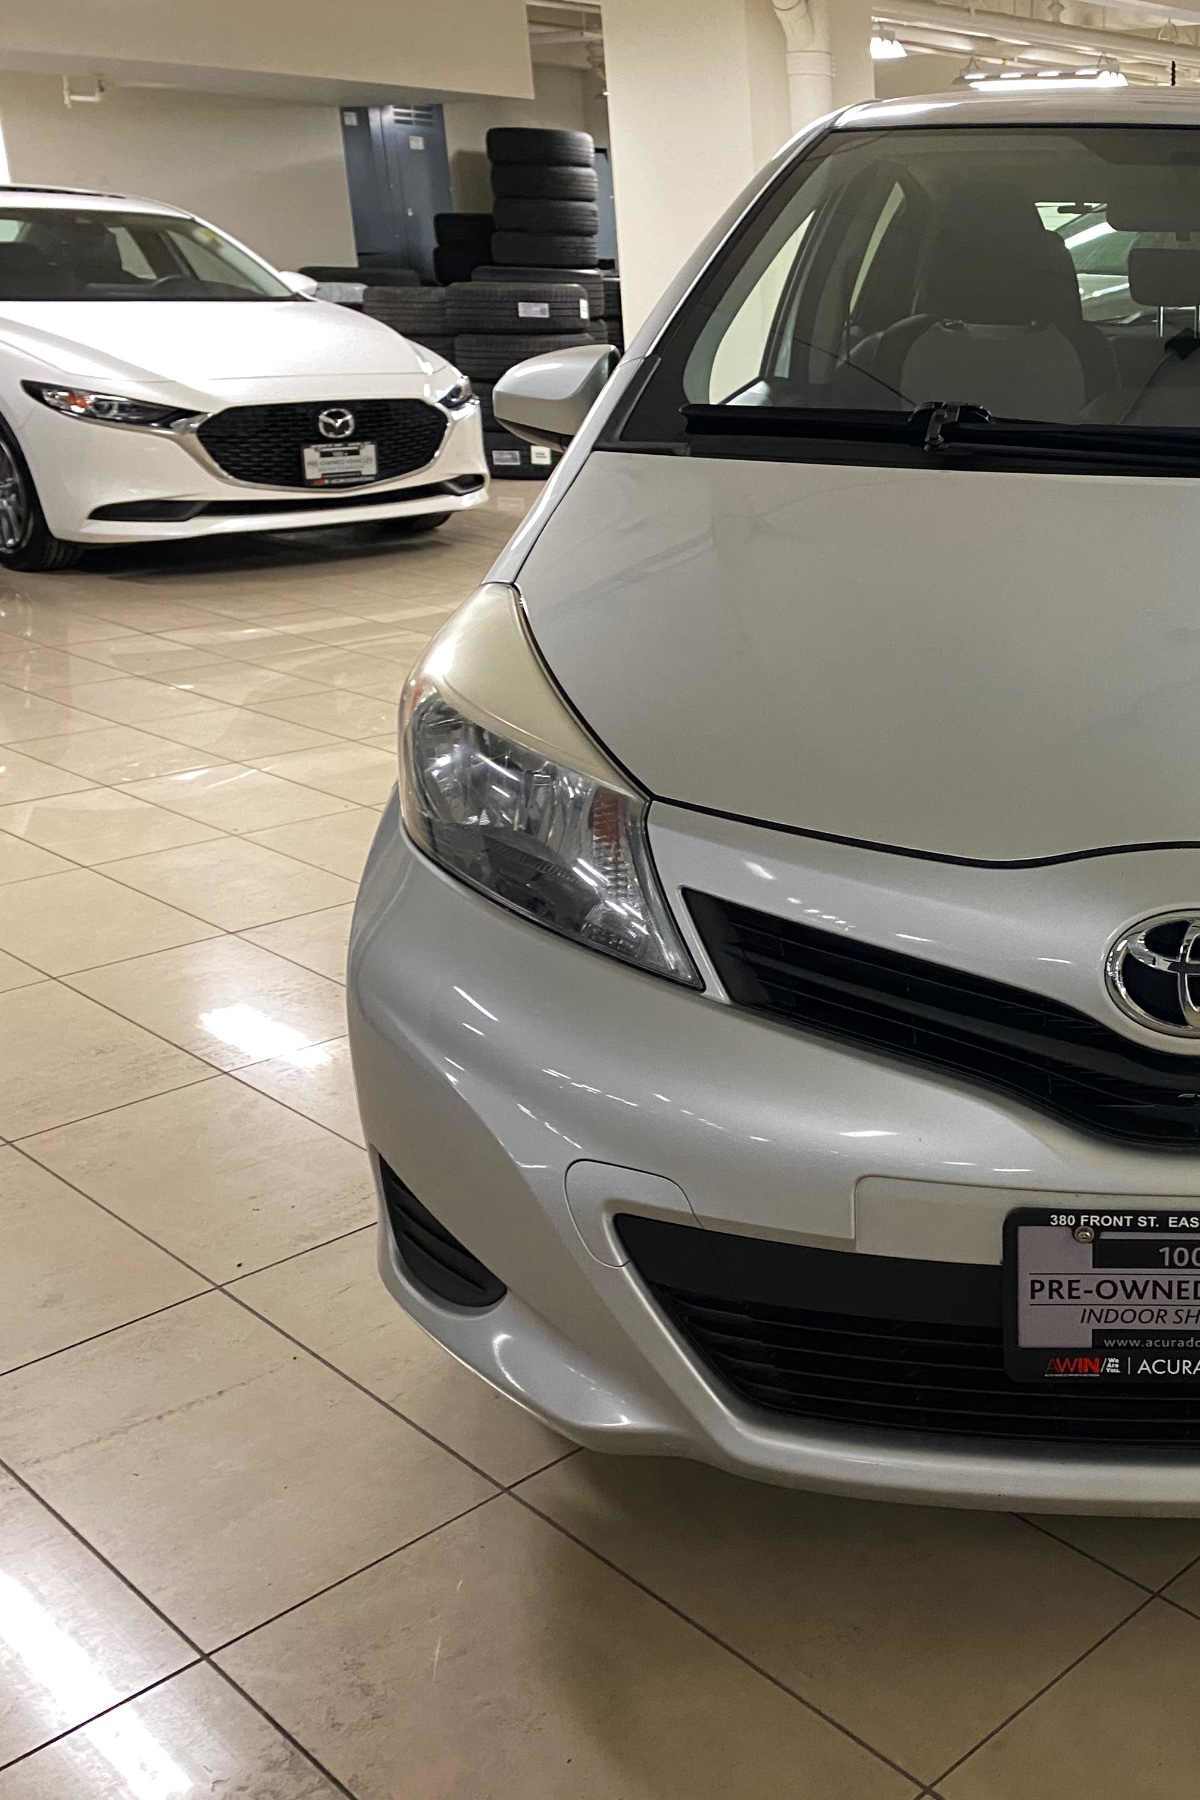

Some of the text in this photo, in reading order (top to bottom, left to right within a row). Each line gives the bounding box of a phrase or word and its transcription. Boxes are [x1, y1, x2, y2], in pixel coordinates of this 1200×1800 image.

[1050, 1215, 1075, 1226] 380
[1080, 1215, 1133, 1227] FRONT
[1137, 1216, 1159, 1227] ST.
[1080, 1308, 1167, 1324] INDOOR
